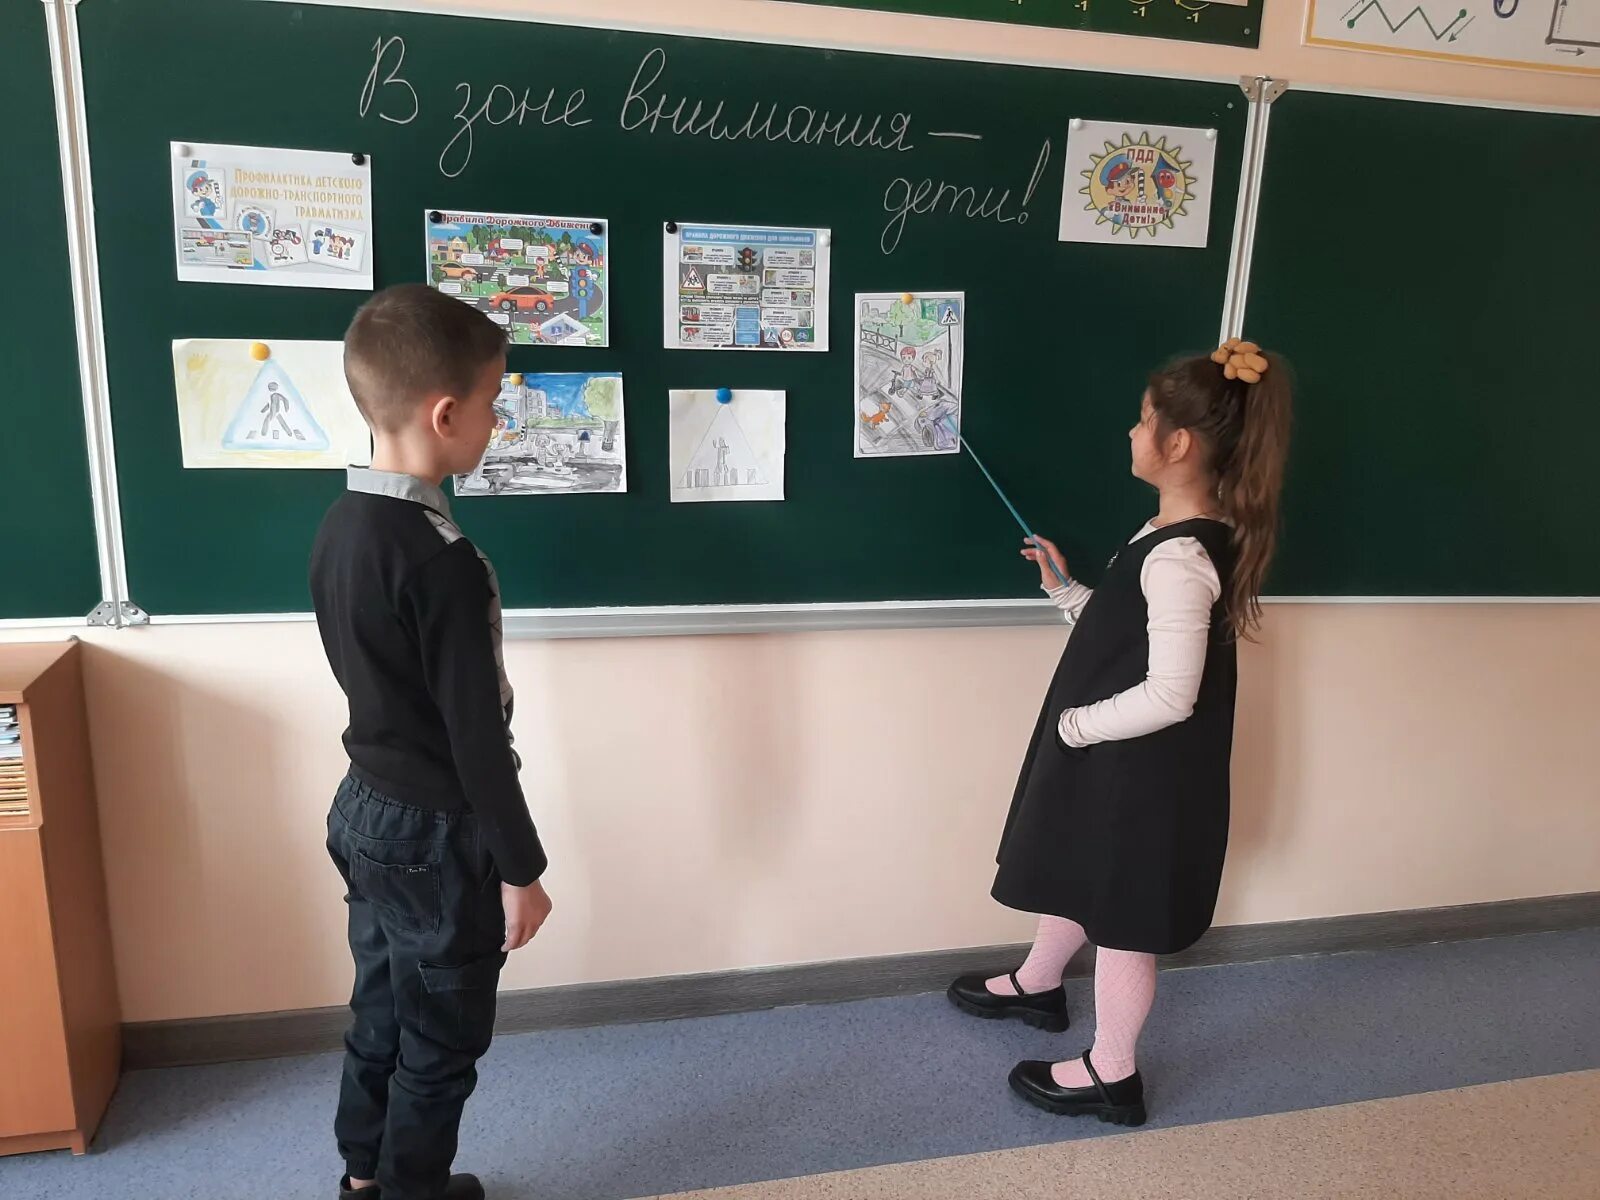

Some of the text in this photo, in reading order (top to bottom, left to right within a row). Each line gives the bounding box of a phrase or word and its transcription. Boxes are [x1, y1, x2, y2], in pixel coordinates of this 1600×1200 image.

[1074, 0, 1087, 11] -1
[1132, 6, 1146, 17] -1
[1186, 12, 1199, 23] -1
[359, 35, 419, 125] В
[439, 81, 593, 177] зоне
[619, 47, 914, 151] внимания
[1127, 148, 1154, 163] ПДД
[880, 138, 1051, 255] дети!
[486, 215, 544, 227] Дорожного
[546, 219, 593, 230] Движени
